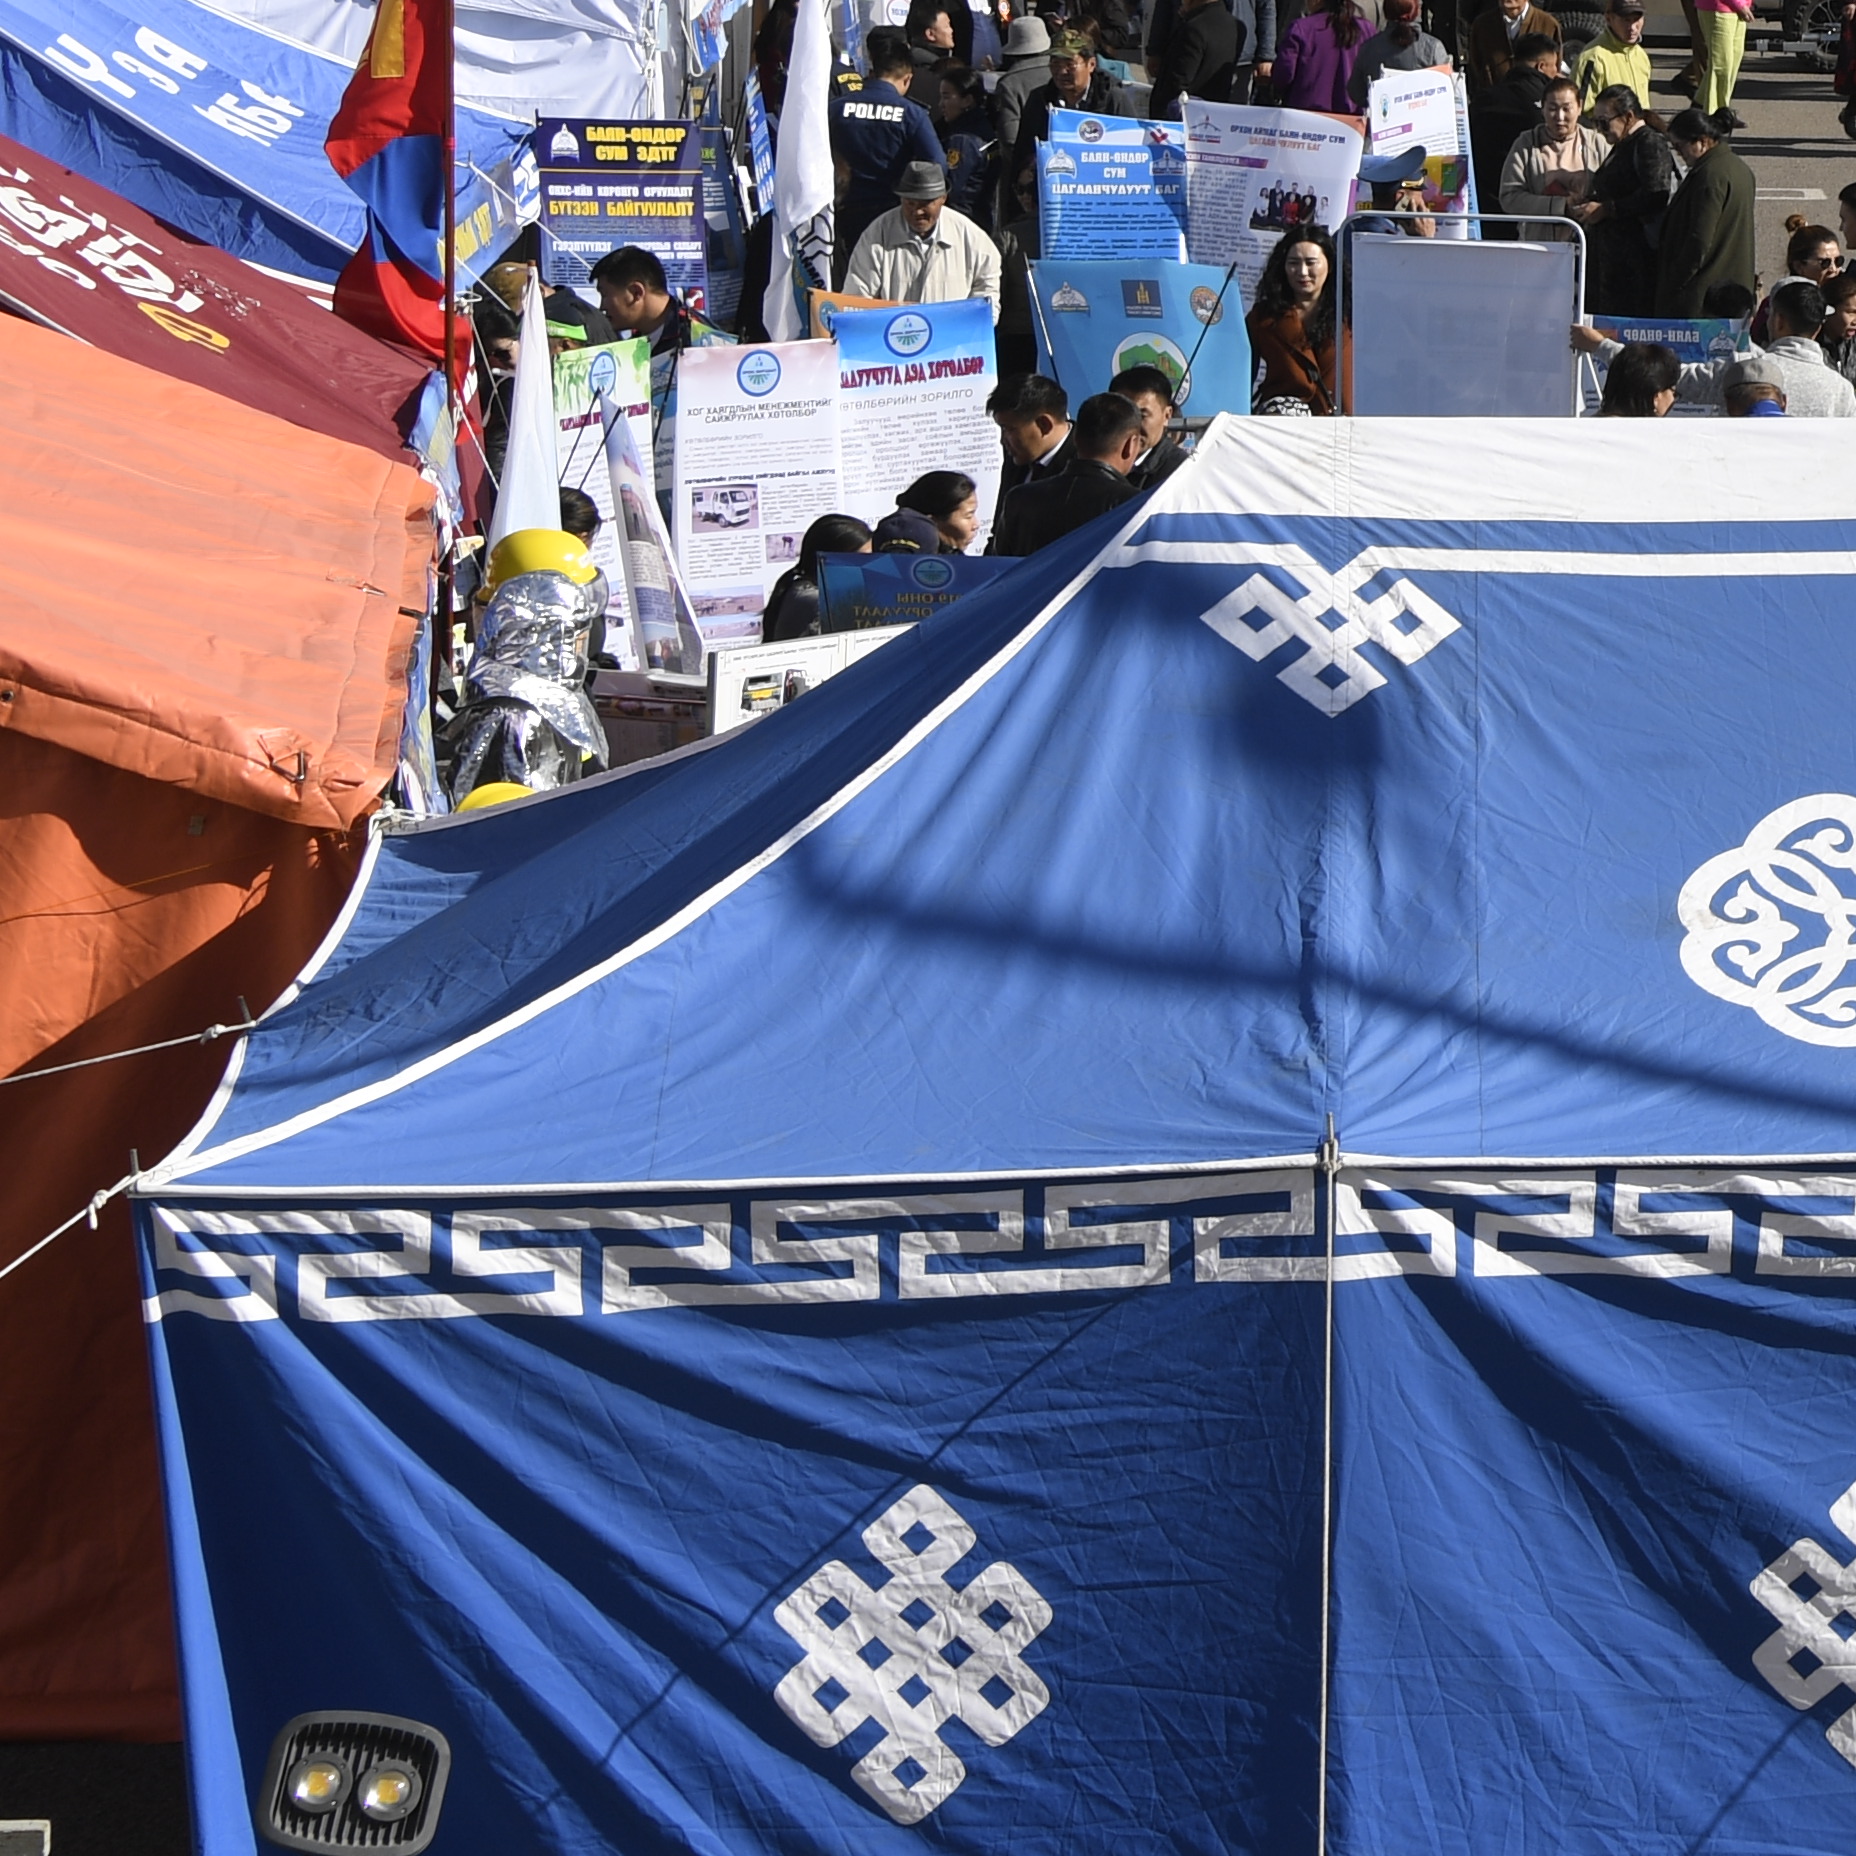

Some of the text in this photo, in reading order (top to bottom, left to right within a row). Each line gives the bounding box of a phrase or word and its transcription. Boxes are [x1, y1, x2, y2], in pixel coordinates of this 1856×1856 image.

[586, 126, 686, 145] БАЯН-ӨНДӨР
[1329, 135, 1346, 144] СУМ
[596, 146, 628, 161] СУМ
[1081, 151, 1149, 163] БАЯН-ӨНДӨР
[1103, 168, 1126, 179] СУМ
[1155, 184, 1180, 194] БАГ
[550, 199, 695, 217] БҮТЭЭН БАЙГУУЛАЛТ
[921, 389, 974, 403] ЗОРИЛГО
[687, 398, 833, 417] ХОГ ХАЯГДЛЫН МЕНЕЖМЕНТИЙГ
[705, 408, 818, 424] САЙЖРУУЛАХ ХӨТӨЛБӨР
